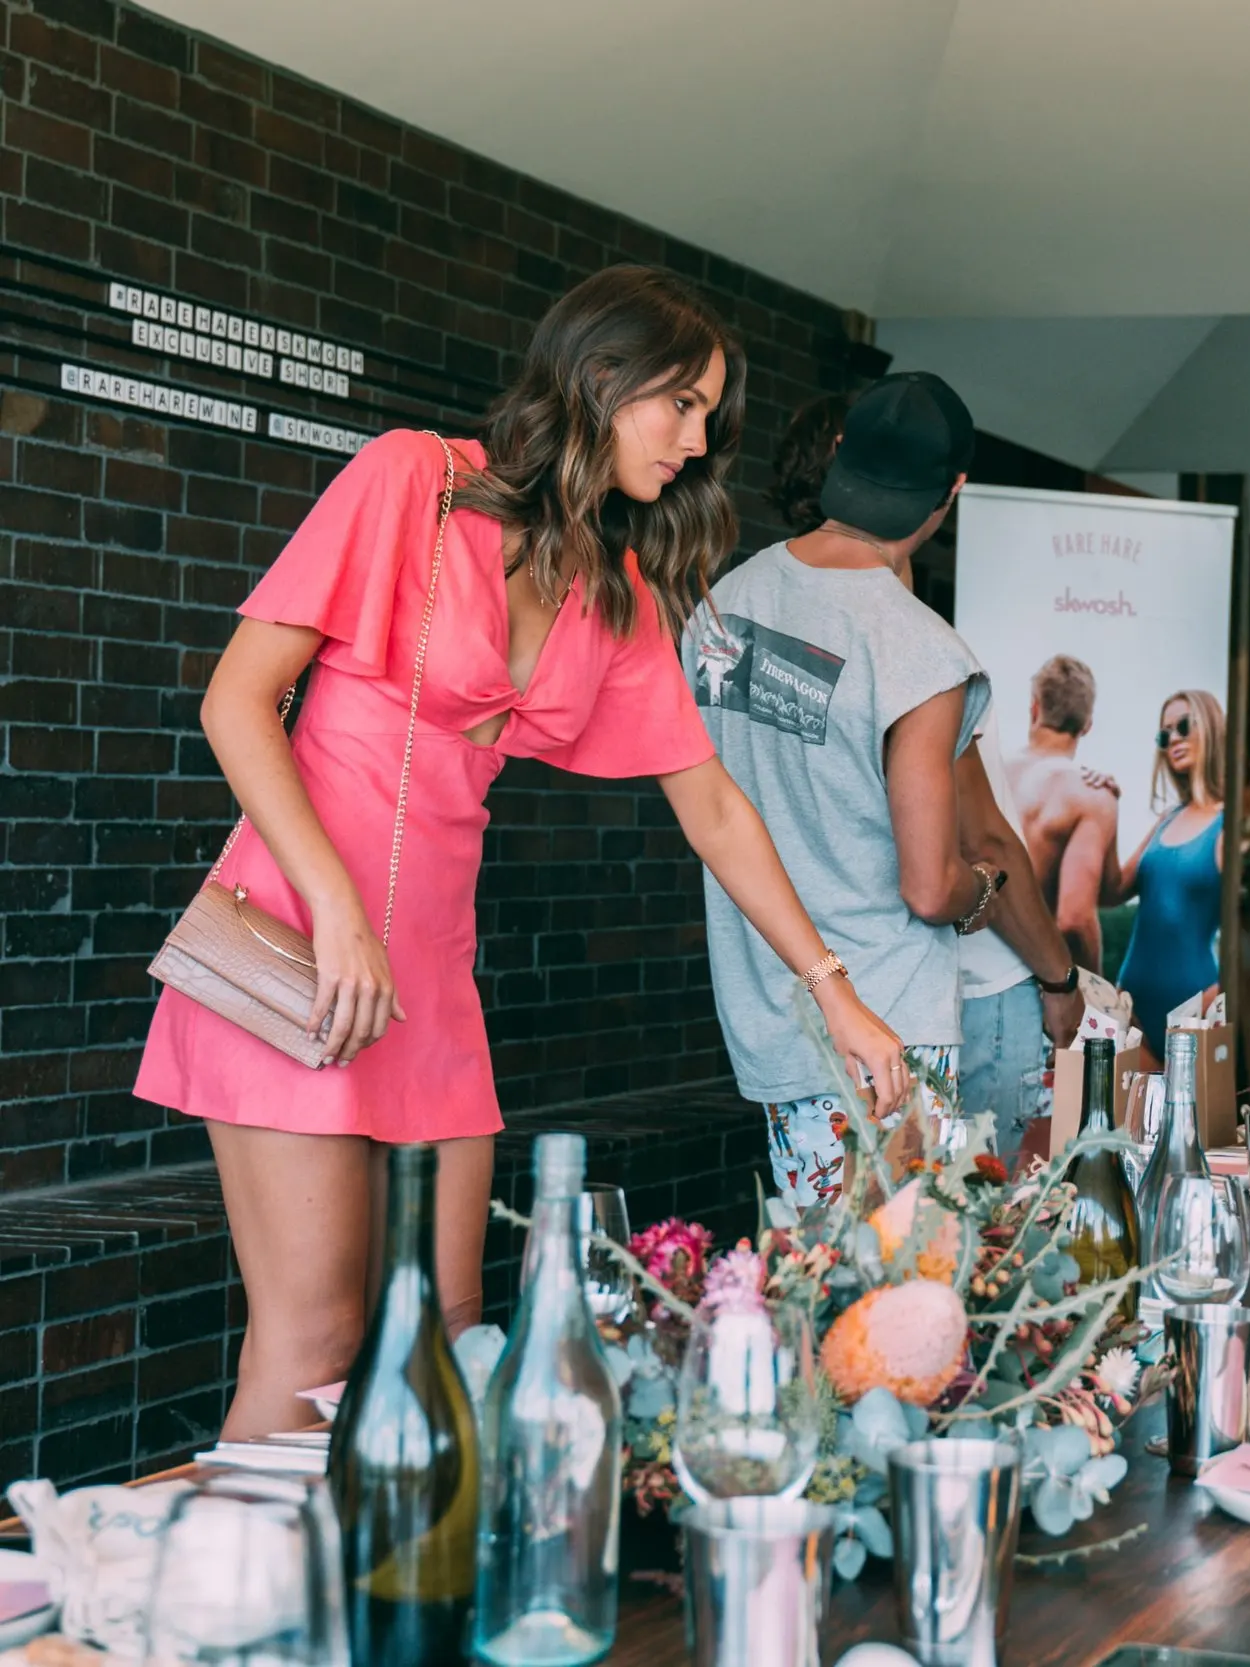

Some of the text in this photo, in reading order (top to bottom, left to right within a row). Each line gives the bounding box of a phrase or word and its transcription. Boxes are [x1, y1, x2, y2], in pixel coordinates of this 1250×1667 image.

[136, 325, 348, 395] EXCLUSIVE SHORT
[65, 369, 254, 429] @RAREHAREWINE
[1052, 532, 1143, 564] RARE HARE
[759, 658, 828, 705] FIREWAGON
